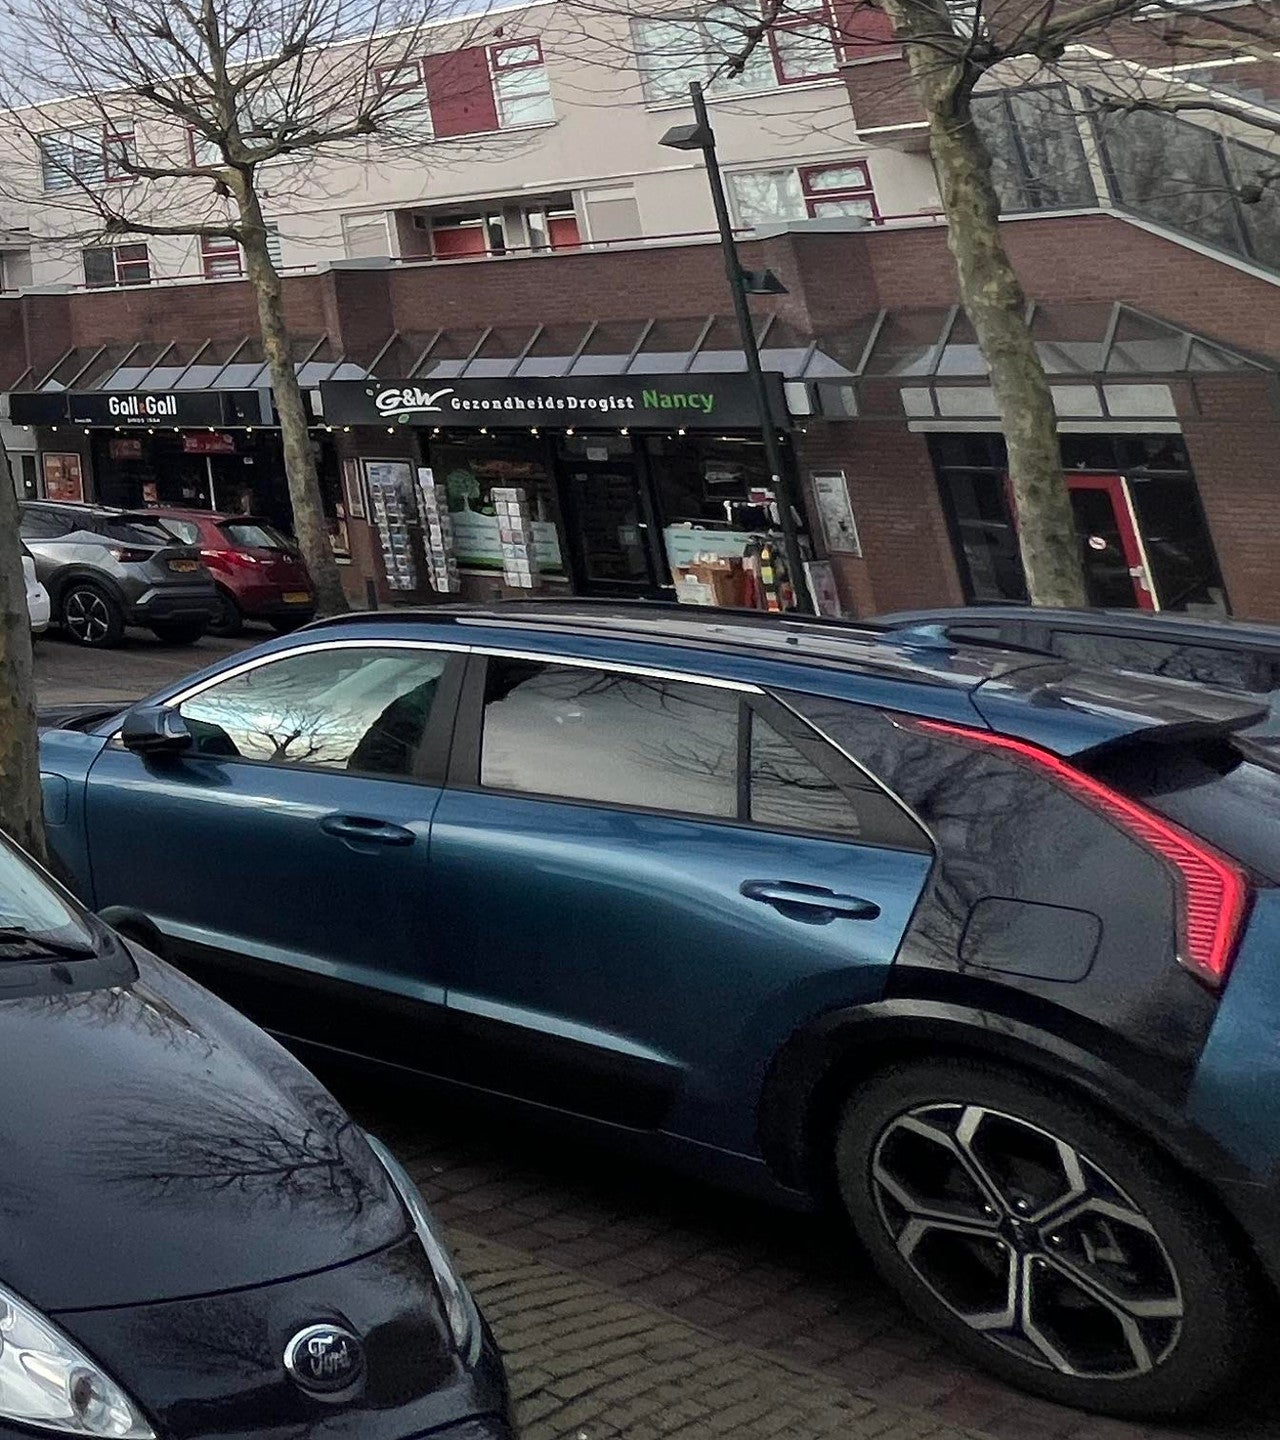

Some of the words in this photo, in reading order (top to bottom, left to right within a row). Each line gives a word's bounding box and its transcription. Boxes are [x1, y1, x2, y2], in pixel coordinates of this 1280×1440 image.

[108, 395, 139, 416] Gall
[145, 395, 177, 416] Gall
[374, 388, 454, 414] G&W
[450, 395, 635, 412] GezondheidsDrogist
[641, 389, 715, 413] Nancy
